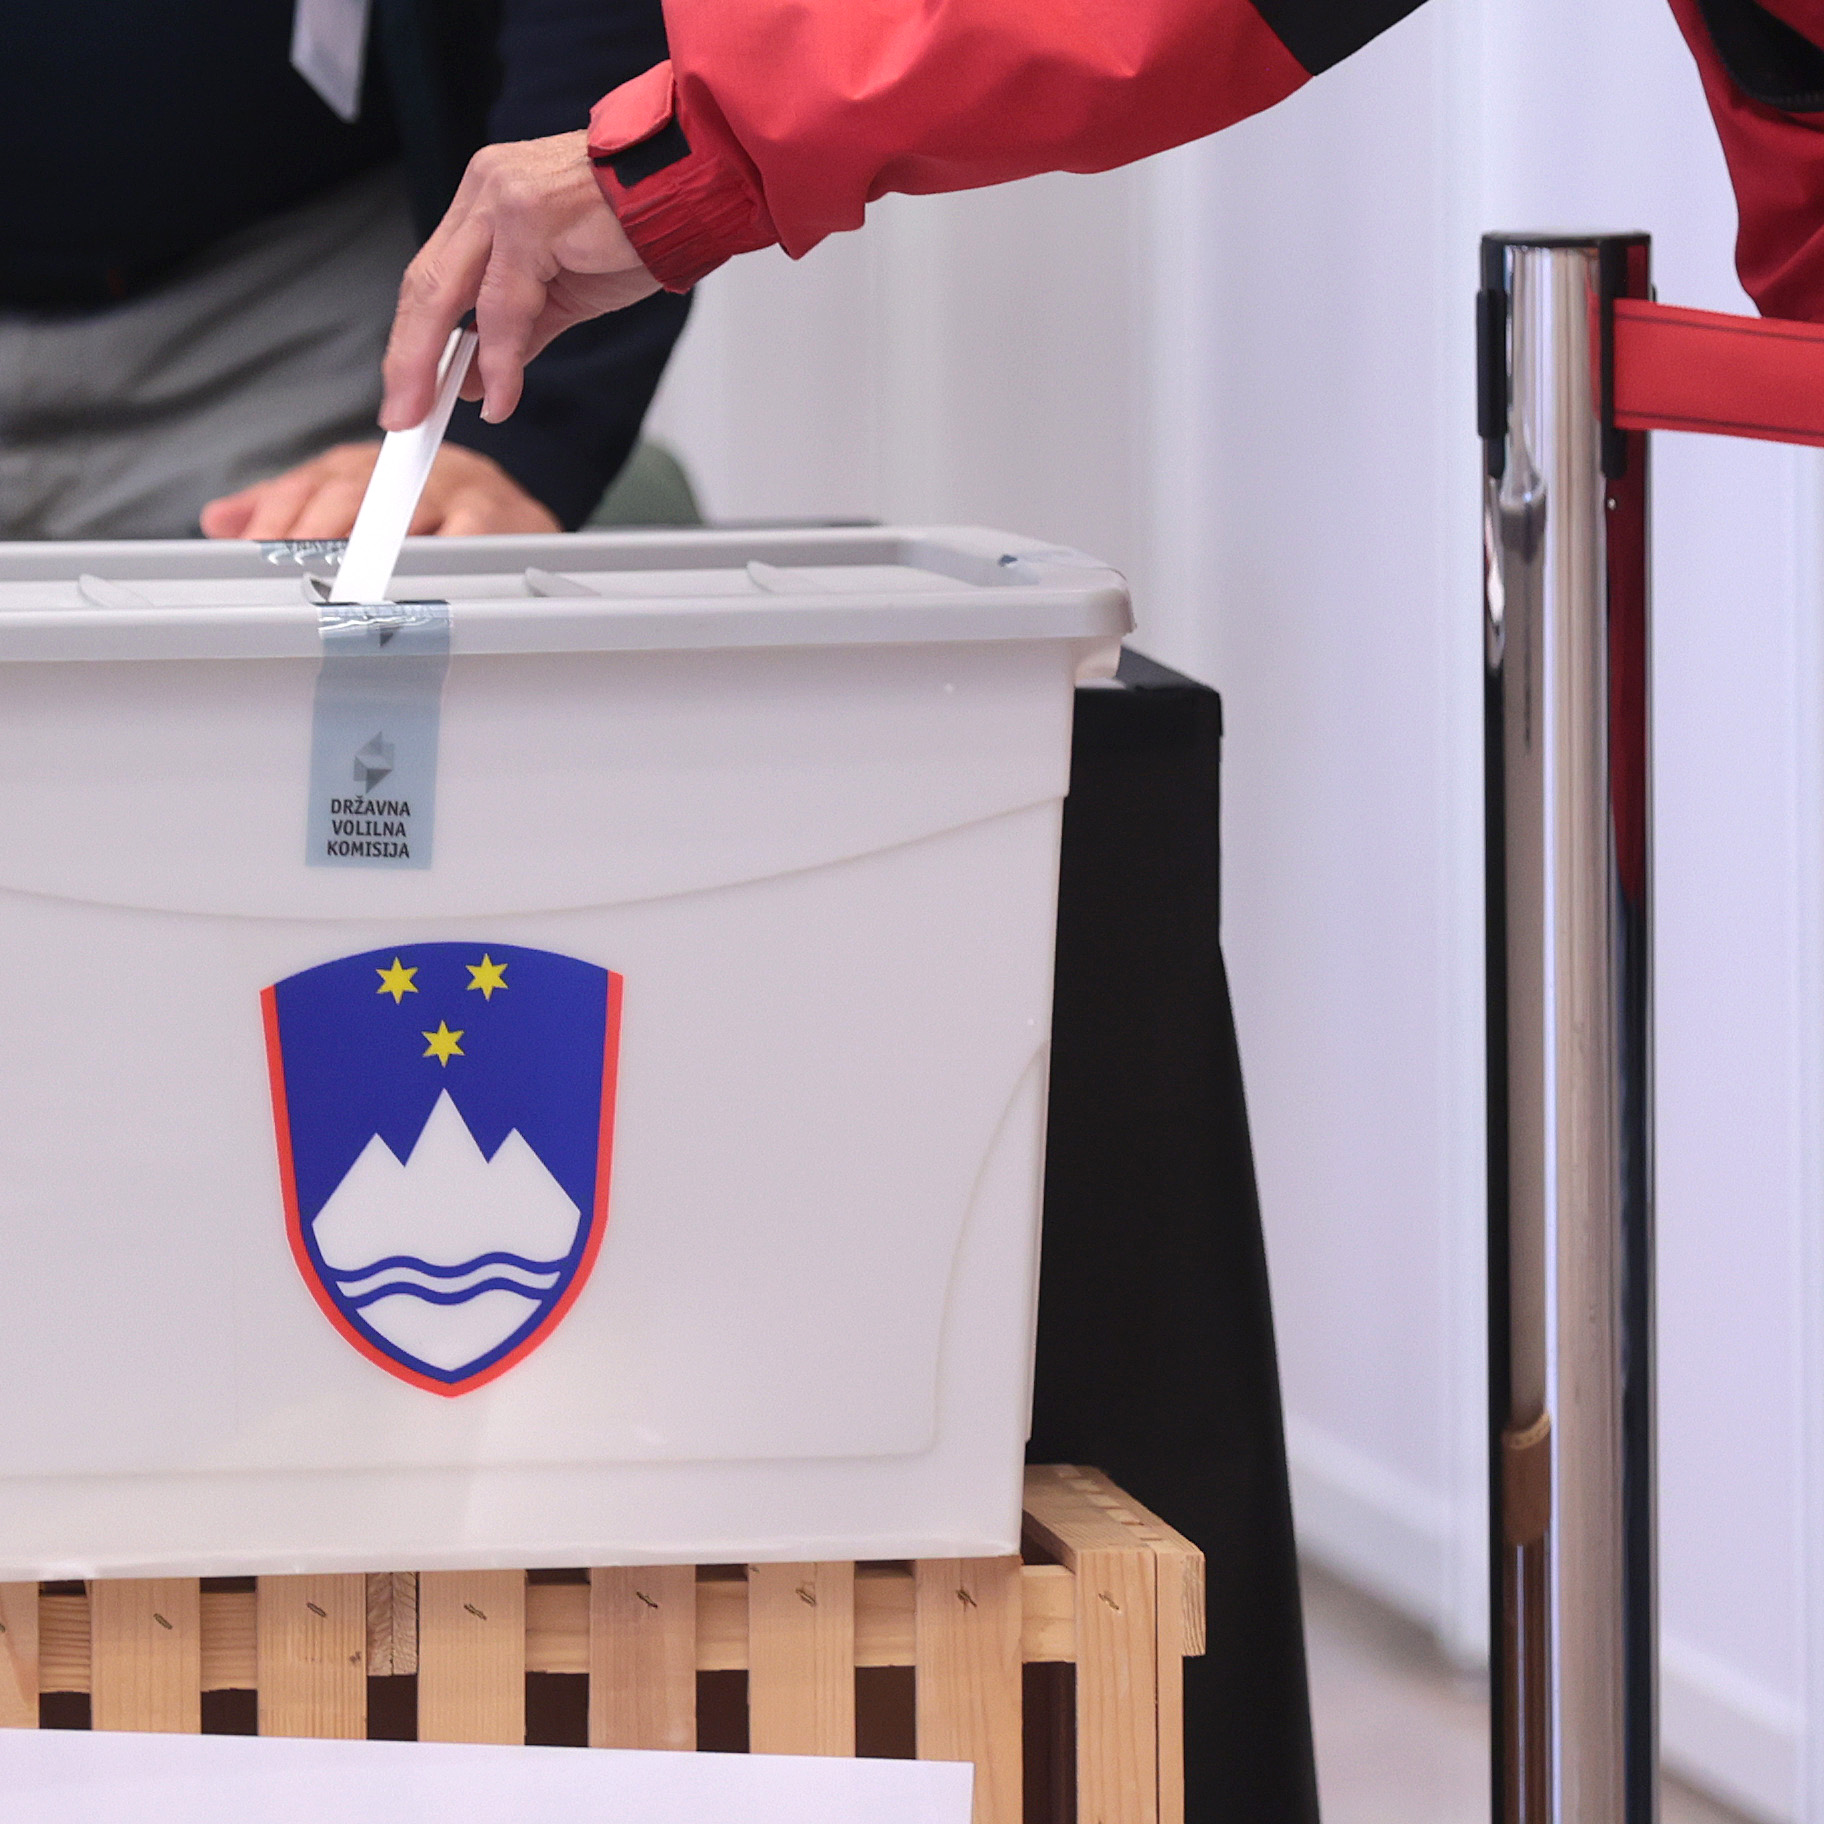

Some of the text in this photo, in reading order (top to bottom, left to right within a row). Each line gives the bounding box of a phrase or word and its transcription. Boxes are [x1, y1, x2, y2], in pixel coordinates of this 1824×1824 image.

[330, 795, 411, 817] DRŽAVNA
[332, 820, 407, 837] VOLILNA
[327, 840, 410, 858] KOMISIJA
